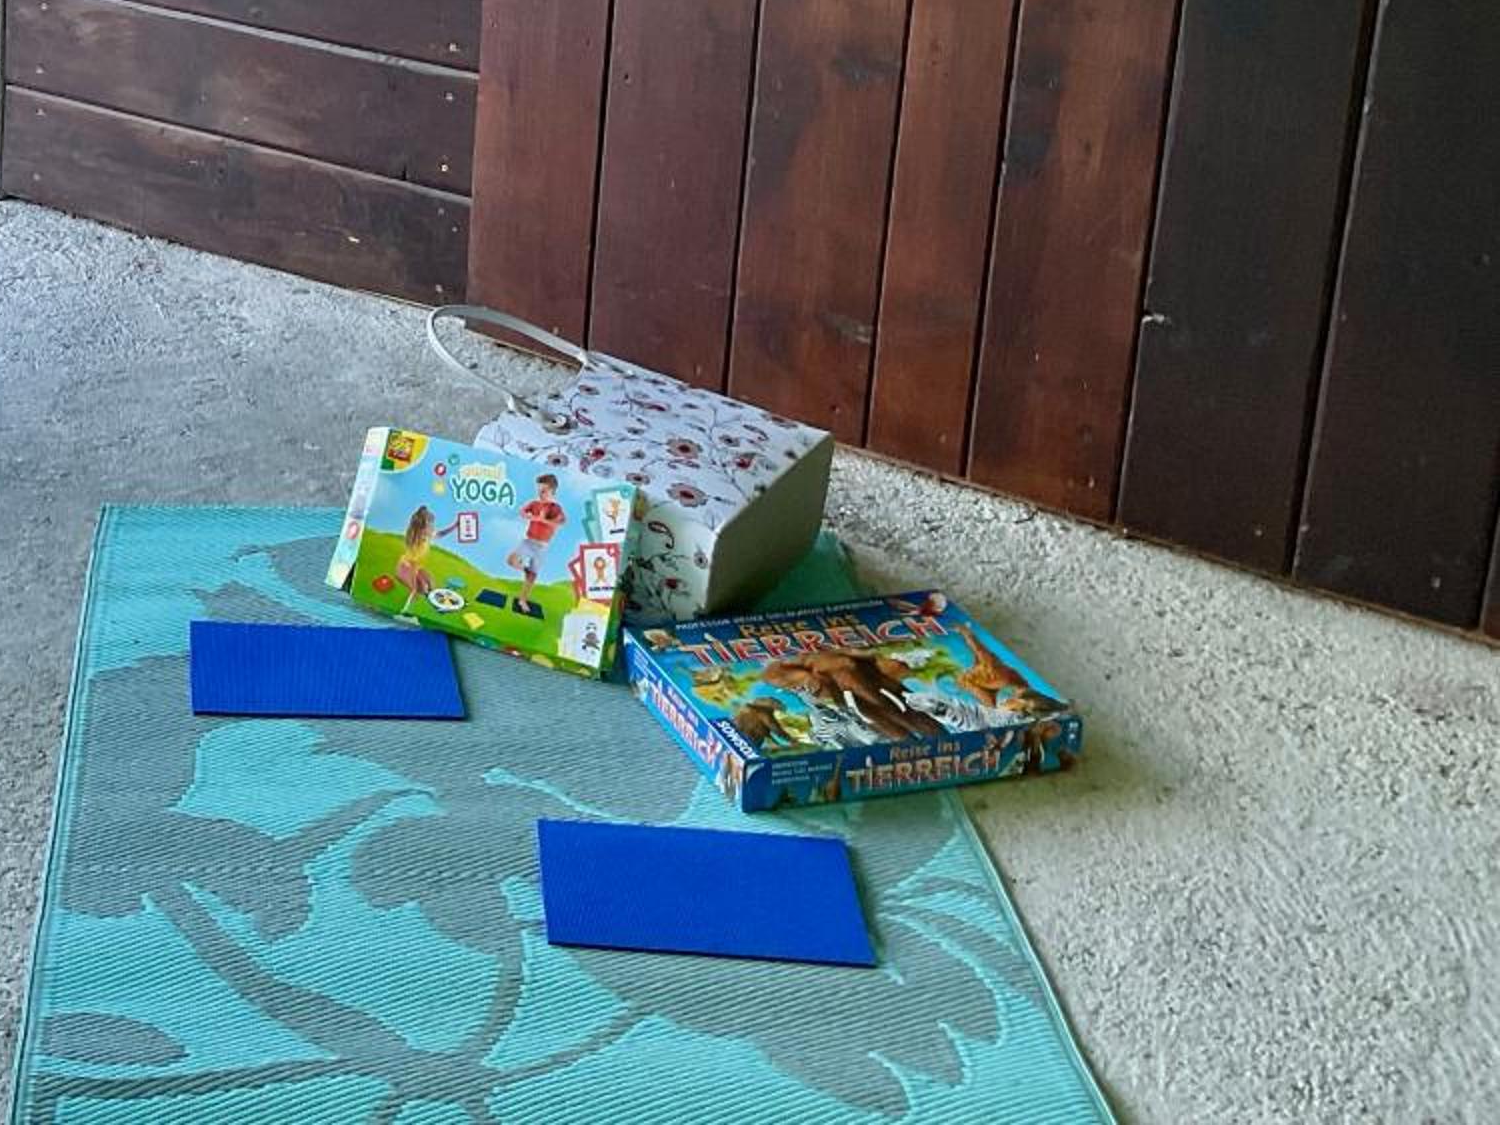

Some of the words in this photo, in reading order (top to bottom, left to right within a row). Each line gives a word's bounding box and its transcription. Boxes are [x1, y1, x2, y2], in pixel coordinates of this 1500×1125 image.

[450, 477, 515, 507] YOGA
[678, 616, 948, 666] TIERREICH
[845, 745, 1003, 792] TIERREICH
